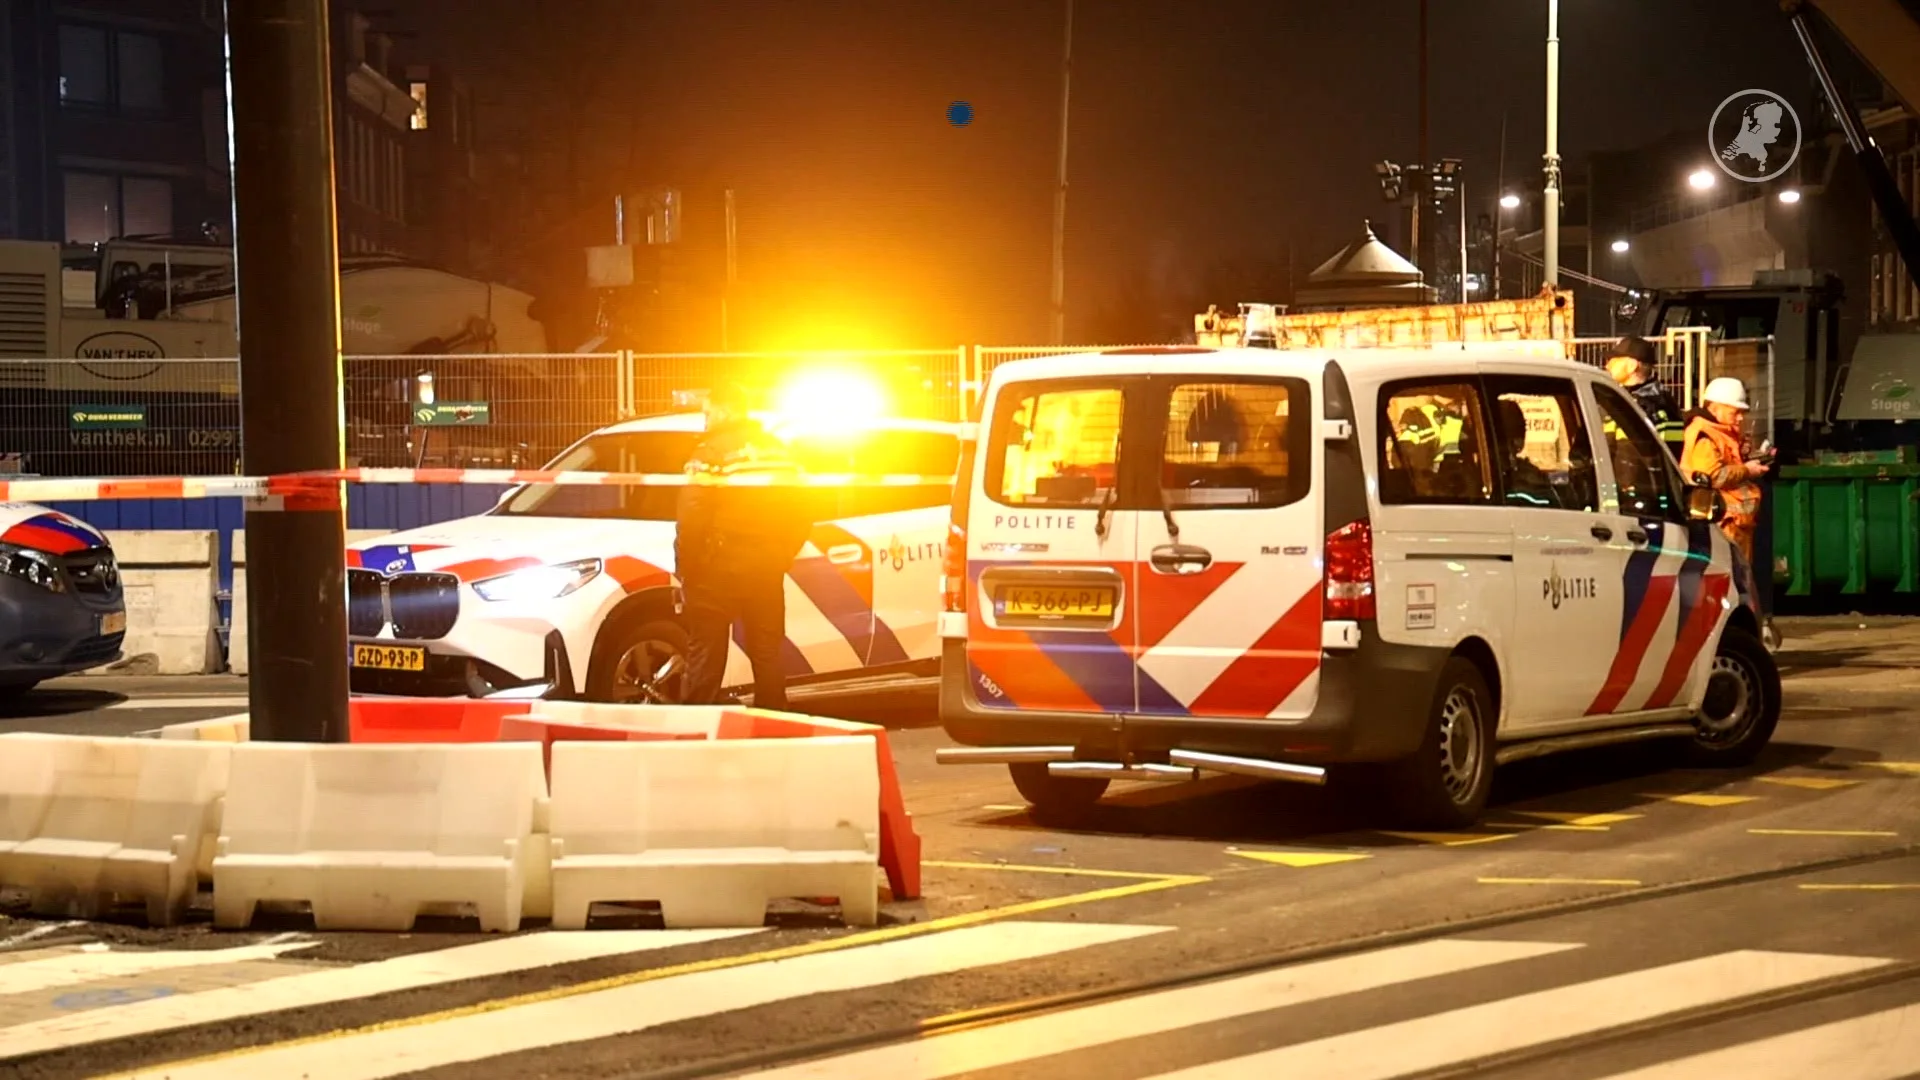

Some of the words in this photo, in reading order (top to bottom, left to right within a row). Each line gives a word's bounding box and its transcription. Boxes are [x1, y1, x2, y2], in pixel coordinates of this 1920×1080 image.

[70, 430, 171, 447] vanthek.nl
[995, 516, 1075, 529] POLITIE
[879, 541, 943, 572] POLITI
[1011, 591, 1102, 612] K-366-PJ
[1543, 576, 1596, 610] POLITIE
[357, 647, 418, 667] GZD-93-P
[979, 673, 1004, 698] 1307
